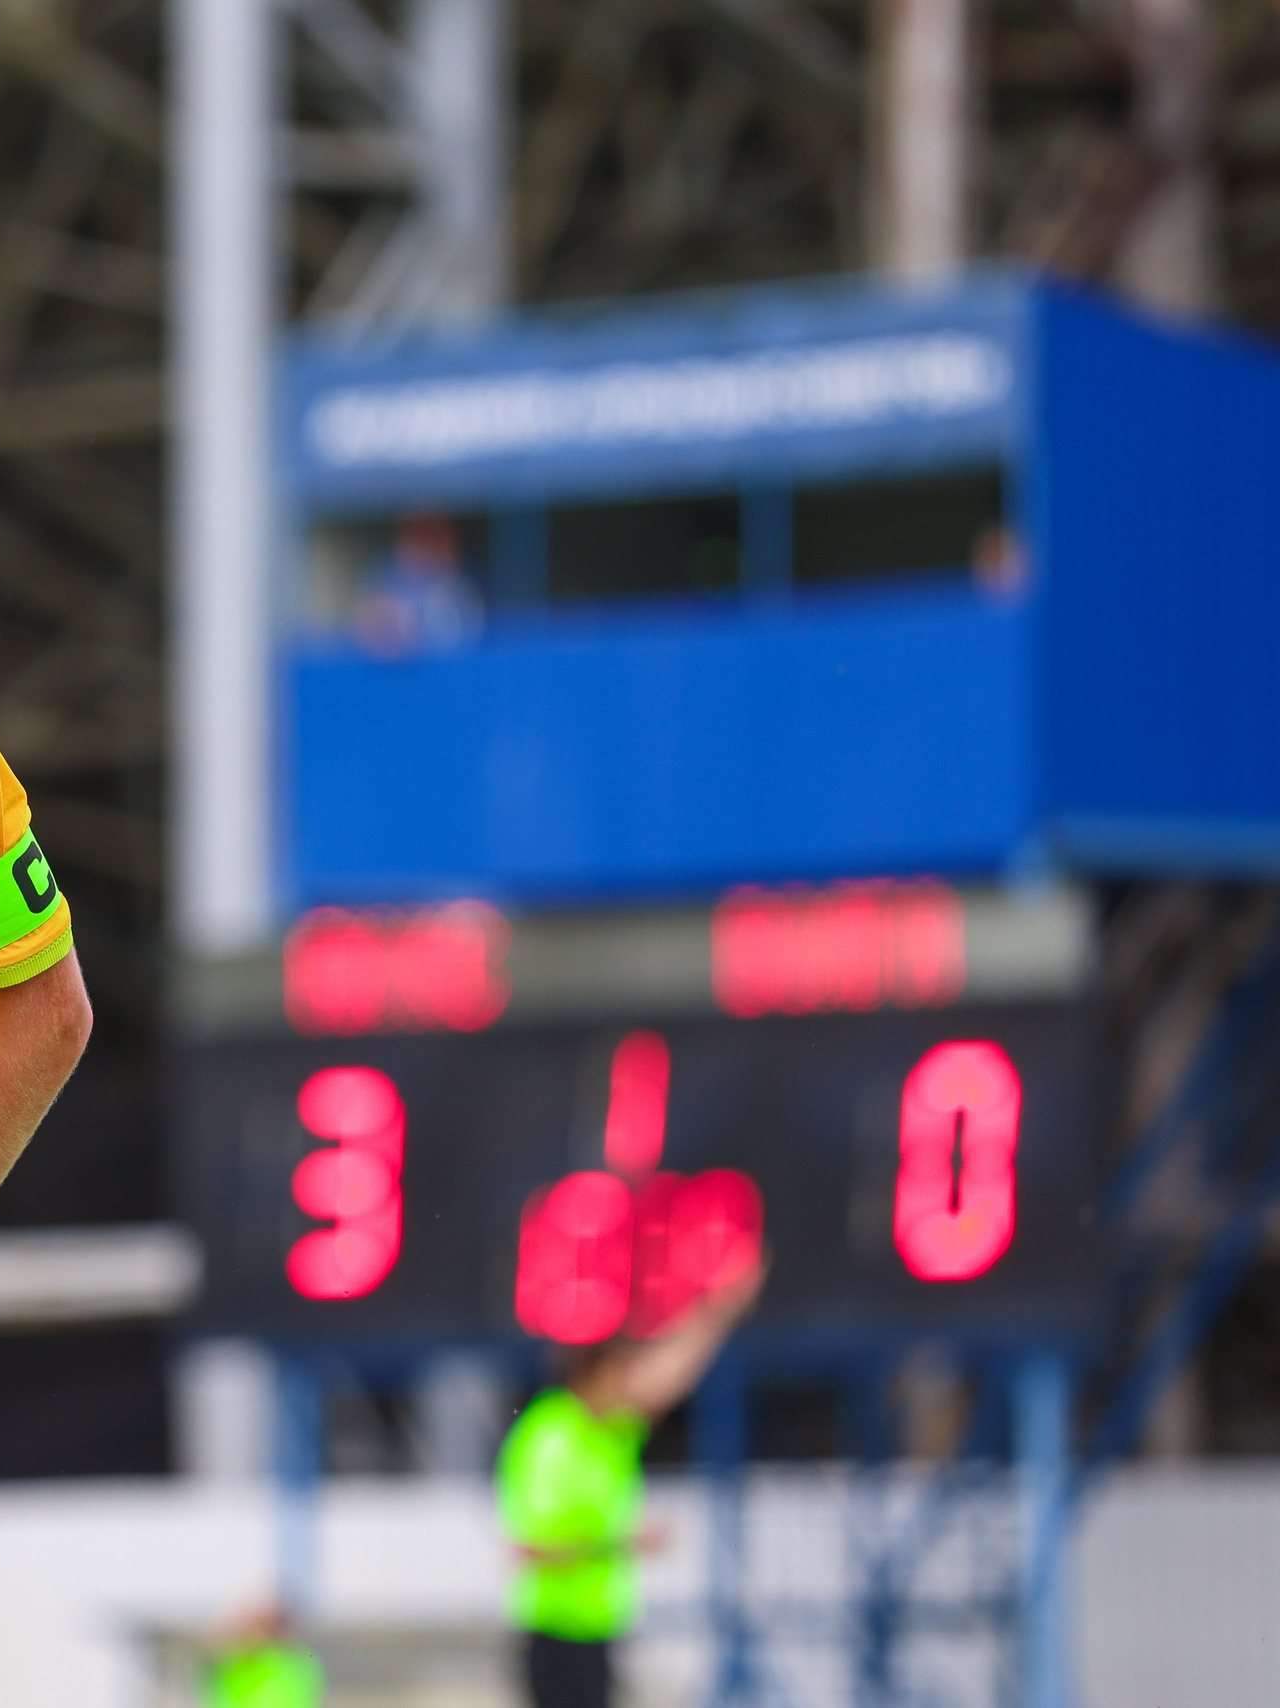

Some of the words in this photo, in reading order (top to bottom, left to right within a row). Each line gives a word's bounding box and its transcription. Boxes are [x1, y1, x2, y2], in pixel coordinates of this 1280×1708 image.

[12, 841, 57, 914] C
[286, 1066, 406, 1301] 3
[894, 1040, 1022, 1282] 0
